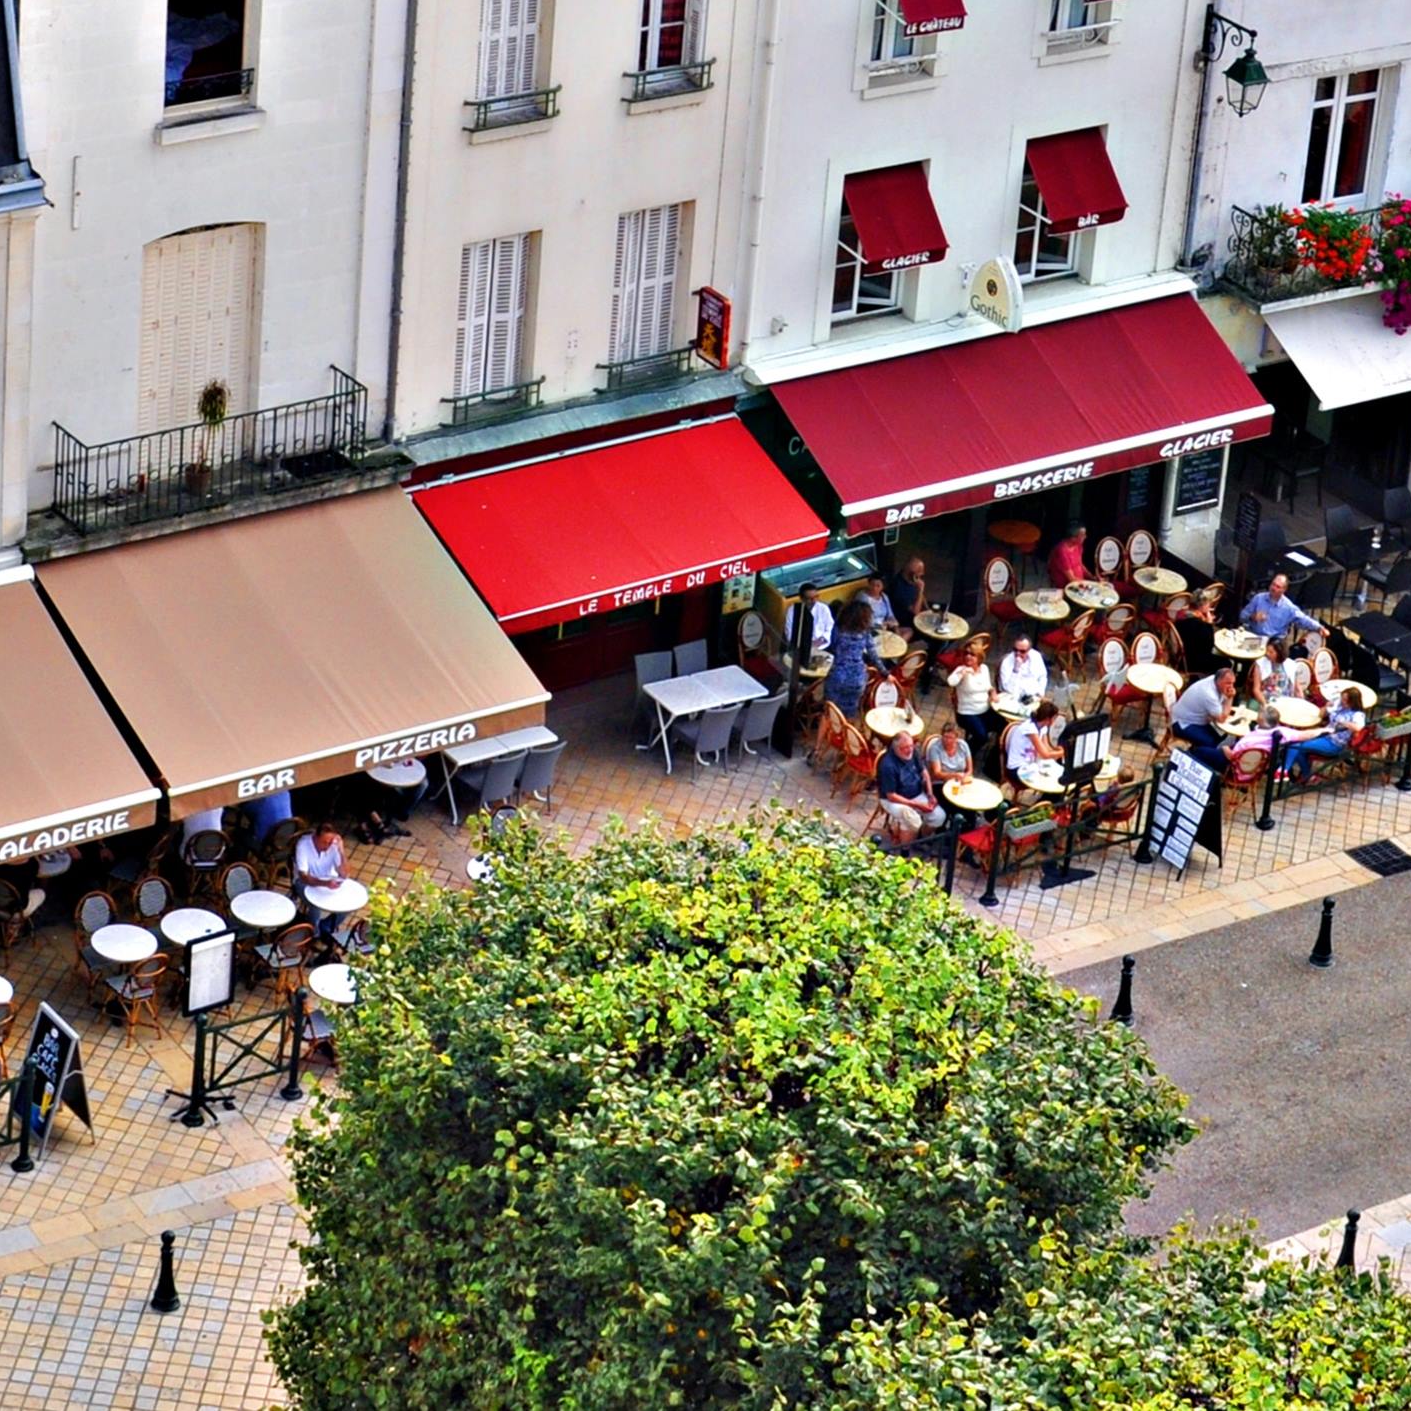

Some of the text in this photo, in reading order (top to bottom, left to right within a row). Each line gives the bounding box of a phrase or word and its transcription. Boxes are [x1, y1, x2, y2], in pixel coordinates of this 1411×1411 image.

[906, 22, 918, 35] LE
[1077, 211, 1100, 227] BAR
[882, 250, 931, 269] GLACIER
[970, 294, 1007, 328] Gothic
[885, 503, 926, 524] BAR
[993, 461, 1094, 499] BRASSERIE
[1159, 428, 1234, 458] GLACIER
[578, 598, 599, 617] LE
[686, 570, 707, 589] DU
[719, 560, 751, 580] CIEL
[237, 722, 477, 799] BAR PIZZERIA
